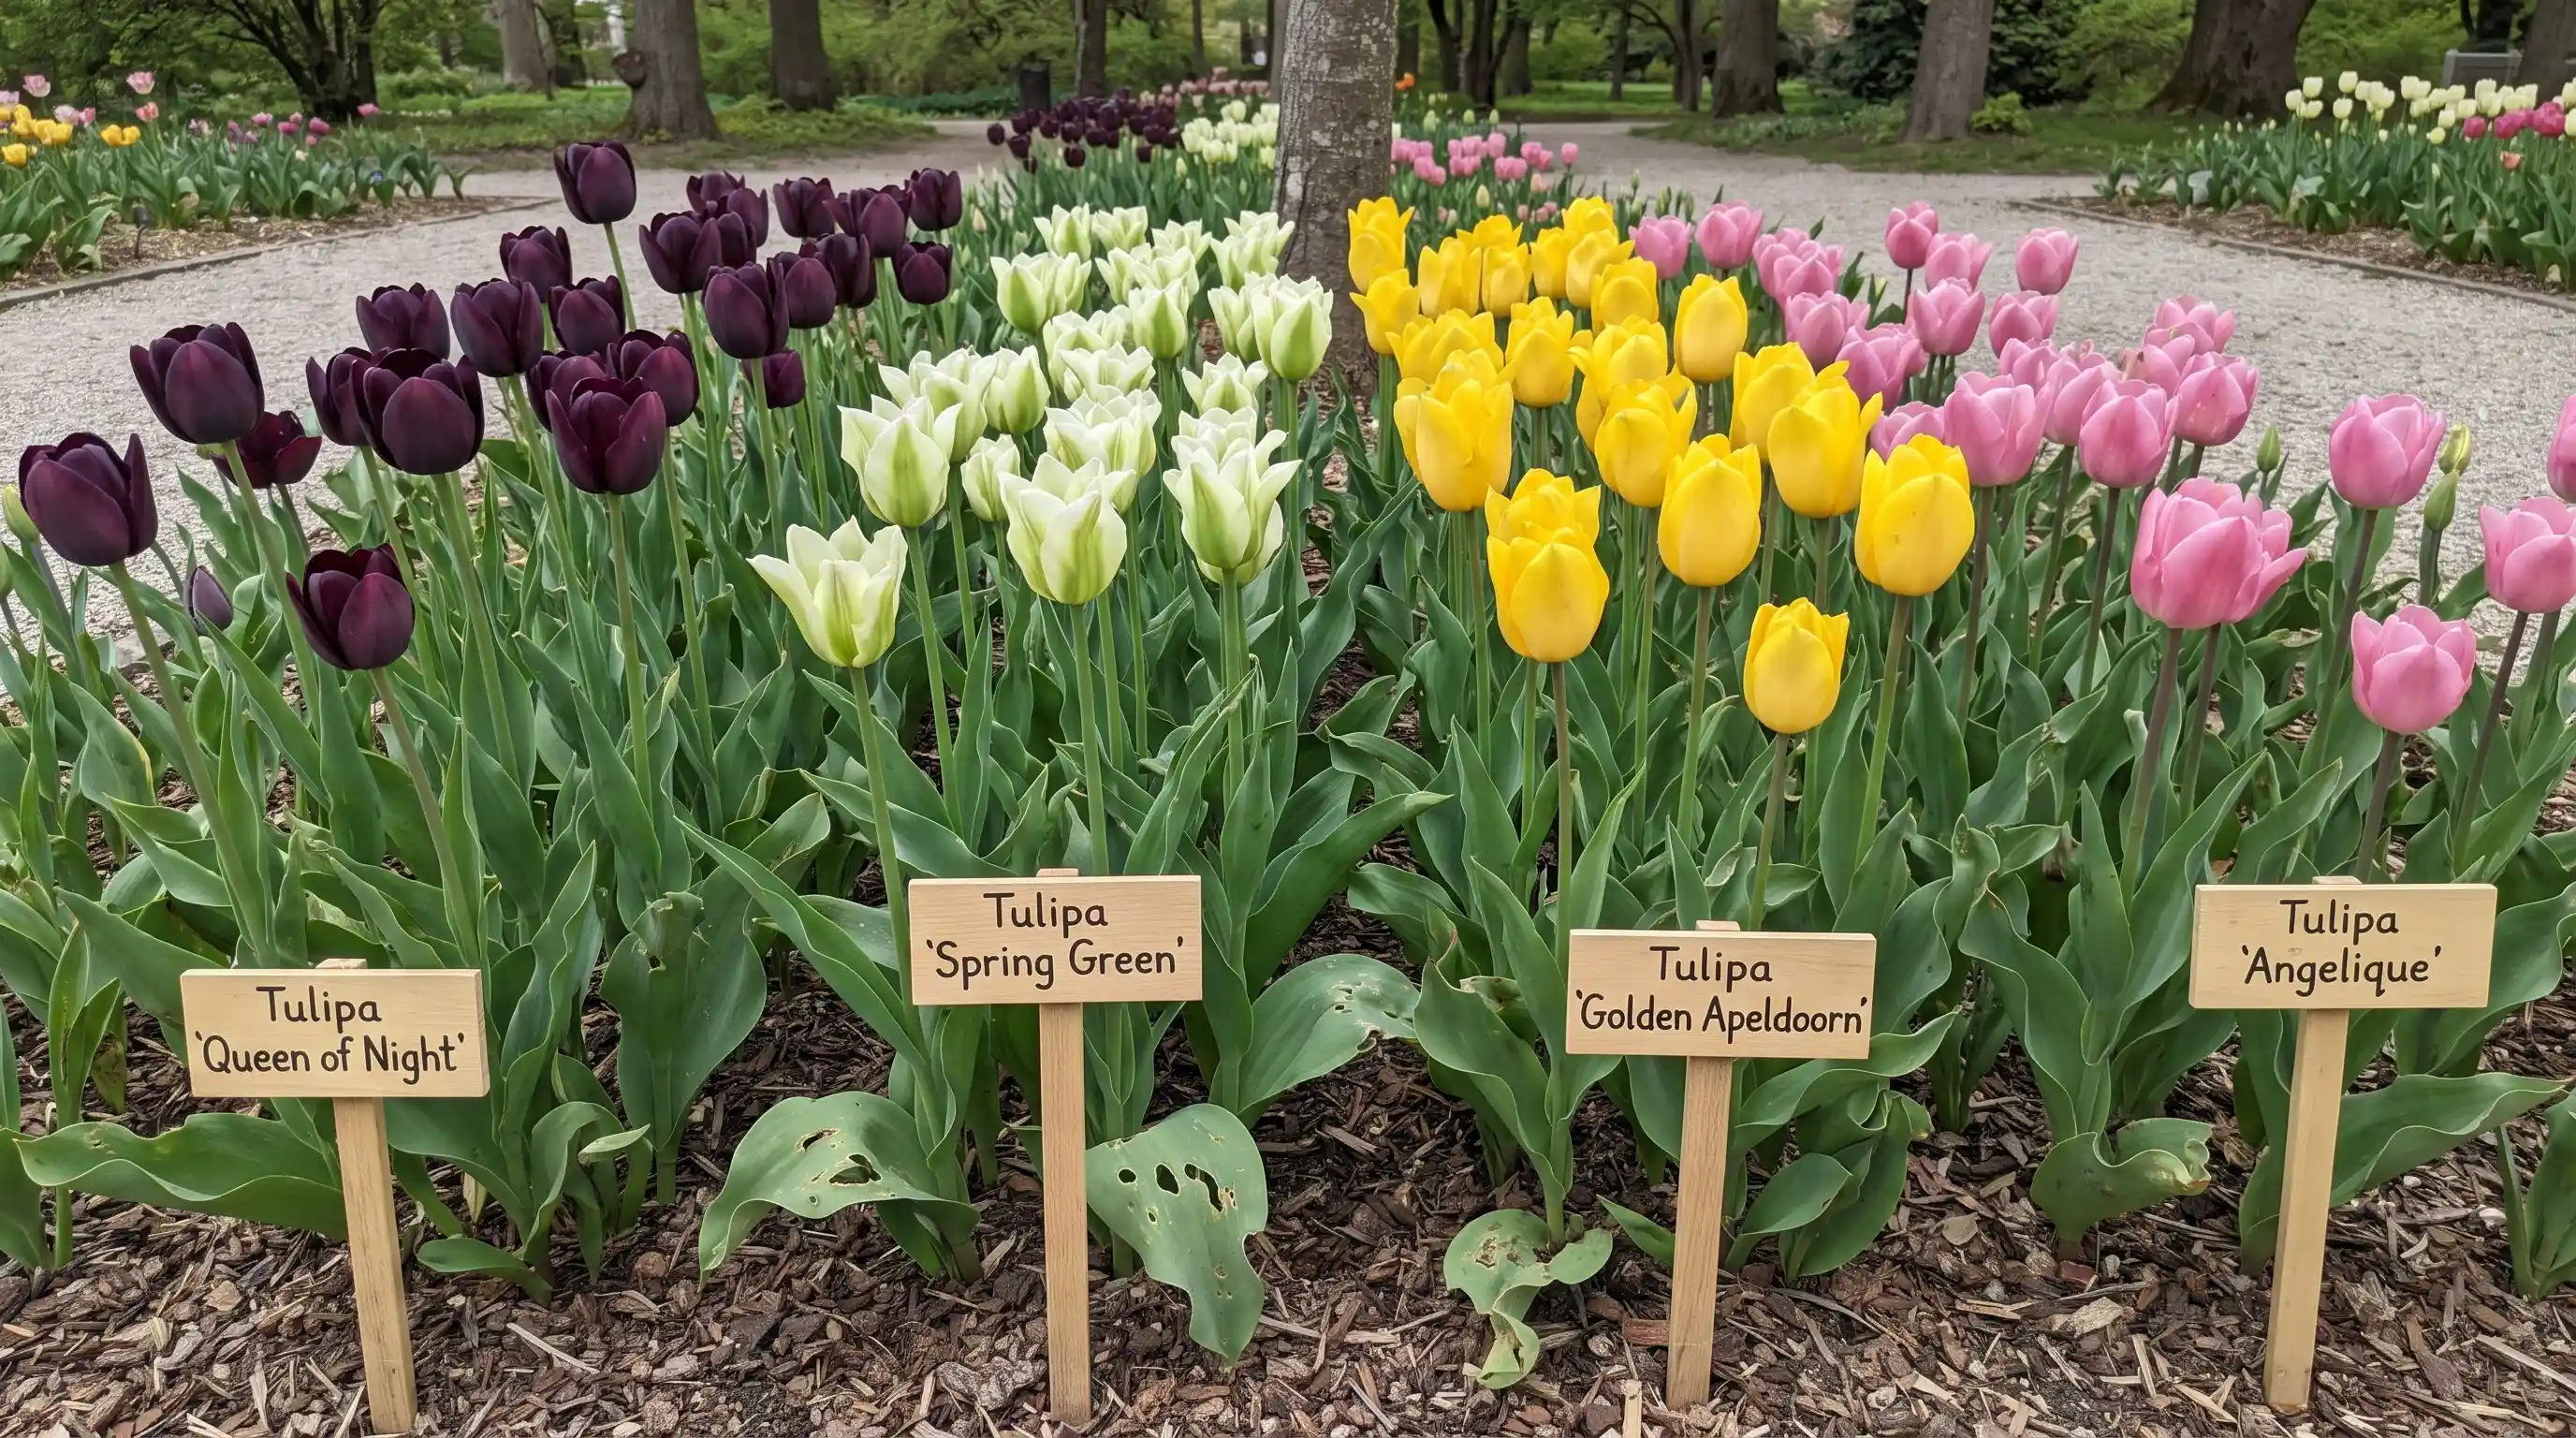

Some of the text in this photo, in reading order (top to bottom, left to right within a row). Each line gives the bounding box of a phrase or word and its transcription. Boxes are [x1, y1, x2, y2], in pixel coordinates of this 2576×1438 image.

[982, 891, 1109, 939] Tulipa
[2279, 898, 2399, 946] Tulipa
[1648, 946, 1774, 993] Tulipa
[255, 985, 383, 1034] Tulipa
[320, 1035, 355, 1072] of
